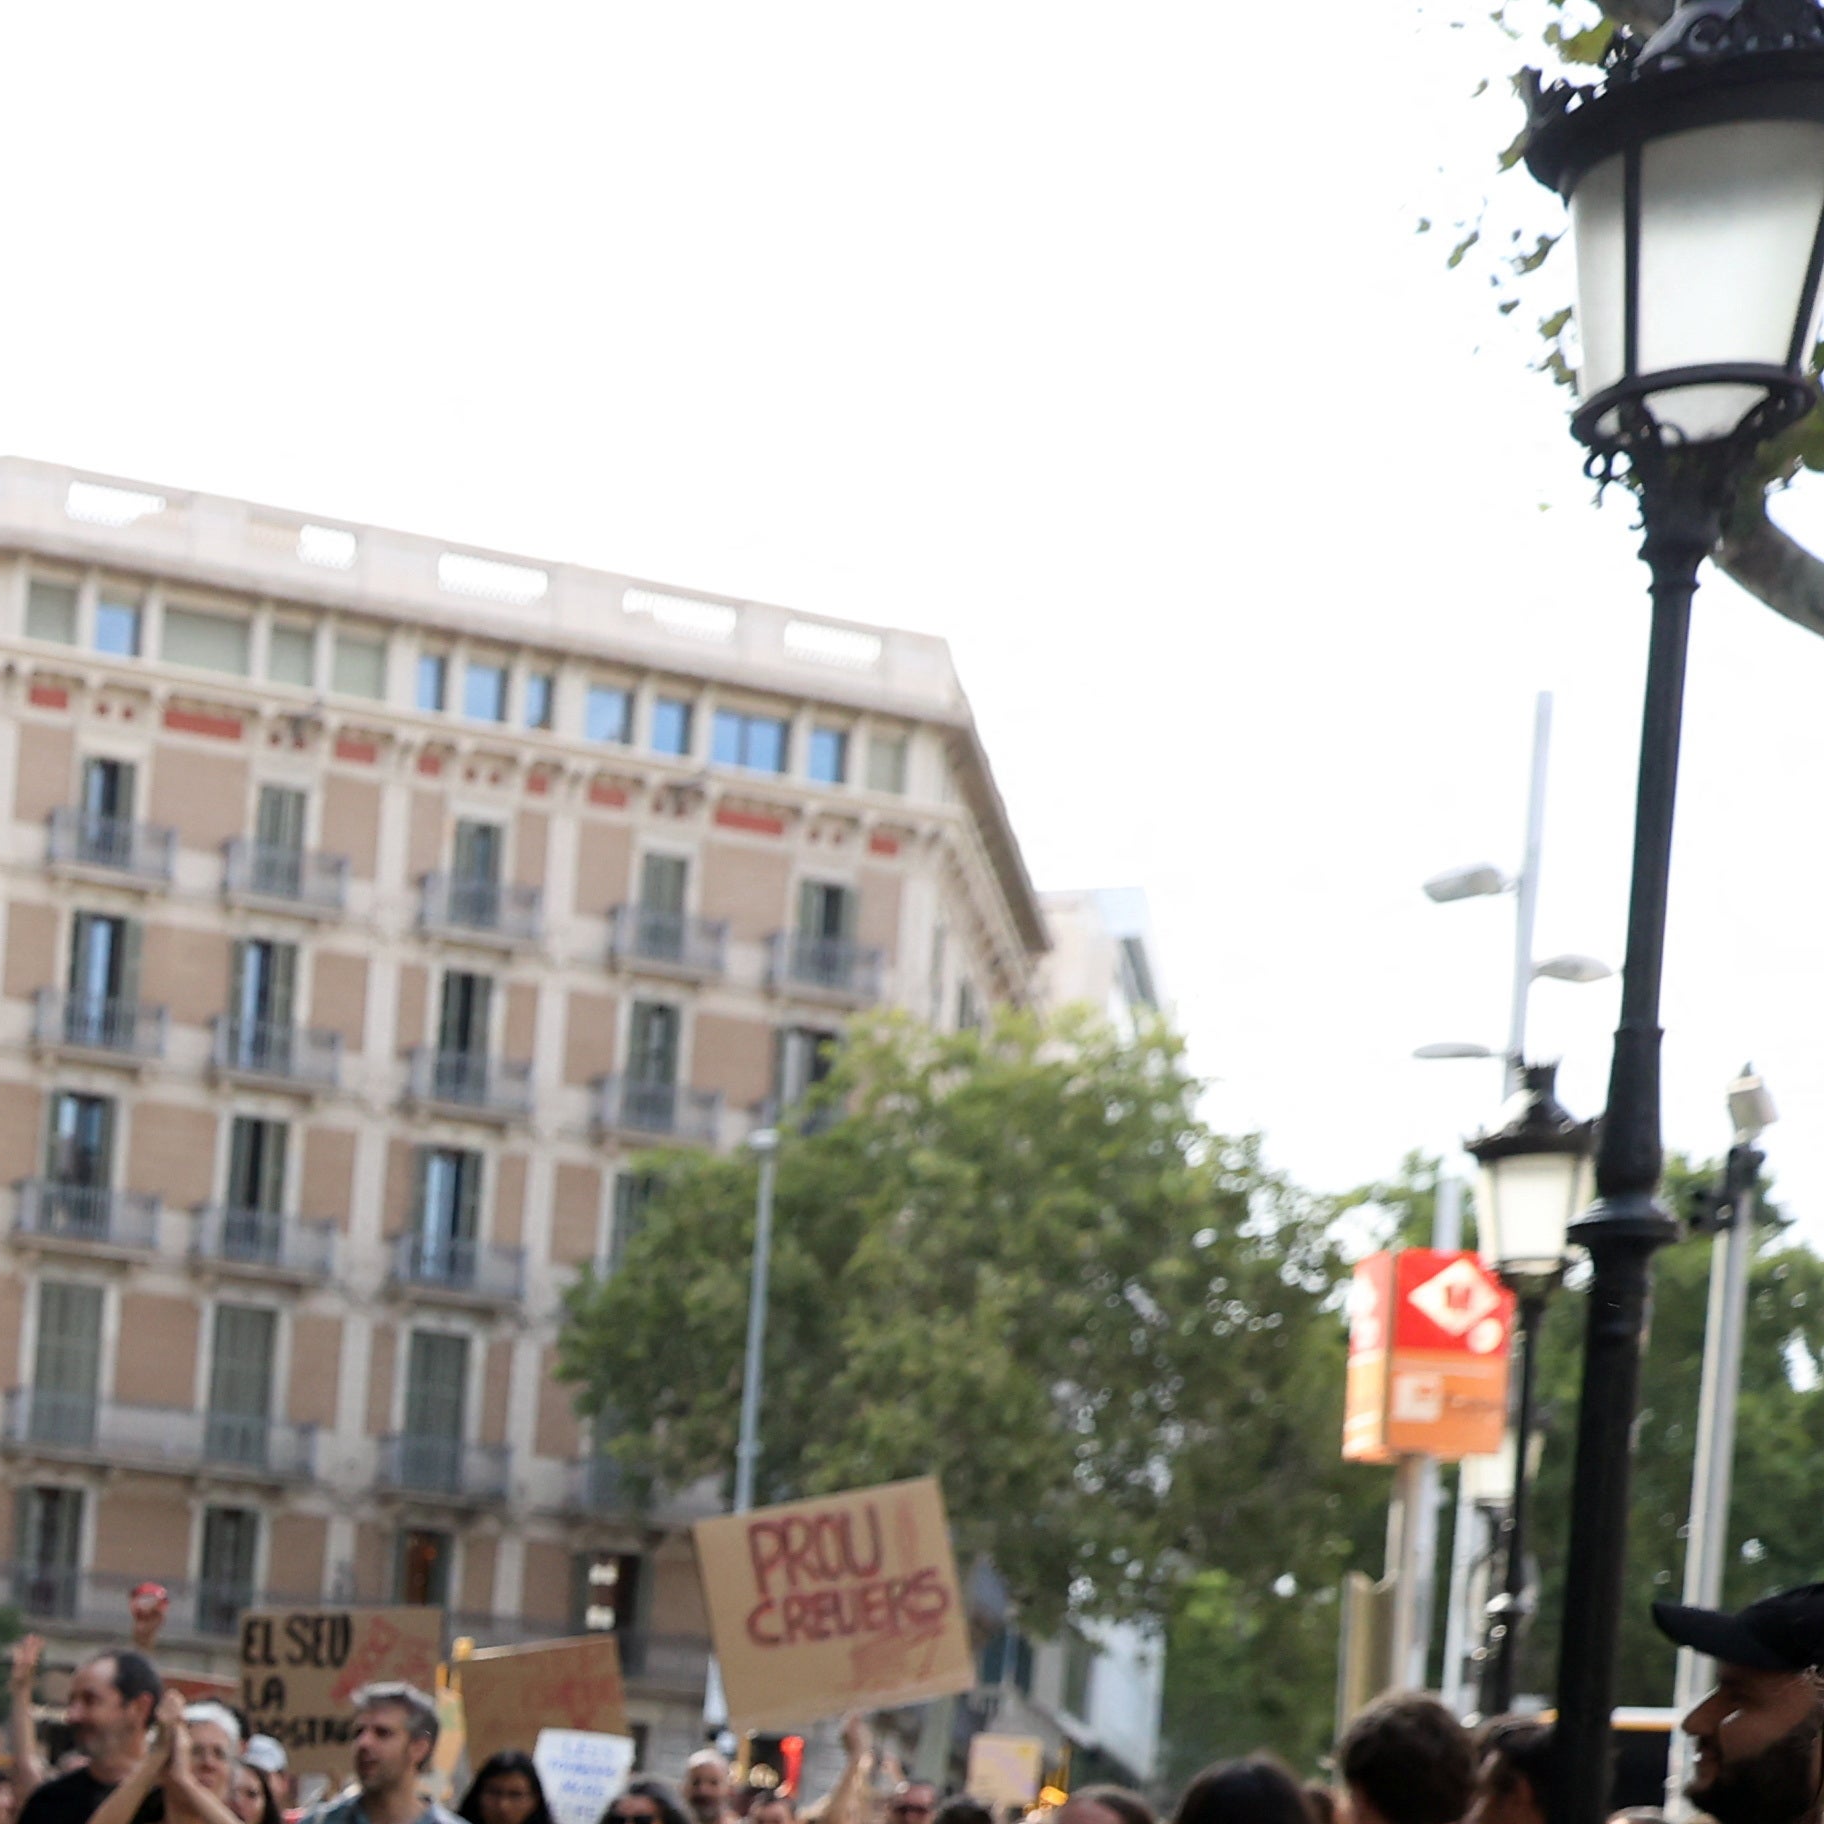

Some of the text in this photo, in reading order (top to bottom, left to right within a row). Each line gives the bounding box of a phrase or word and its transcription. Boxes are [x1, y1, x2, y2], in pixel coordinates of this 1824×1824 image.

[747, 1503, 883, 1601] PROU
[243, 1618, 277, 1667] EL
[285, 1614, 353, 1668] SEU
[243, 1676, 286, 1712] LA
